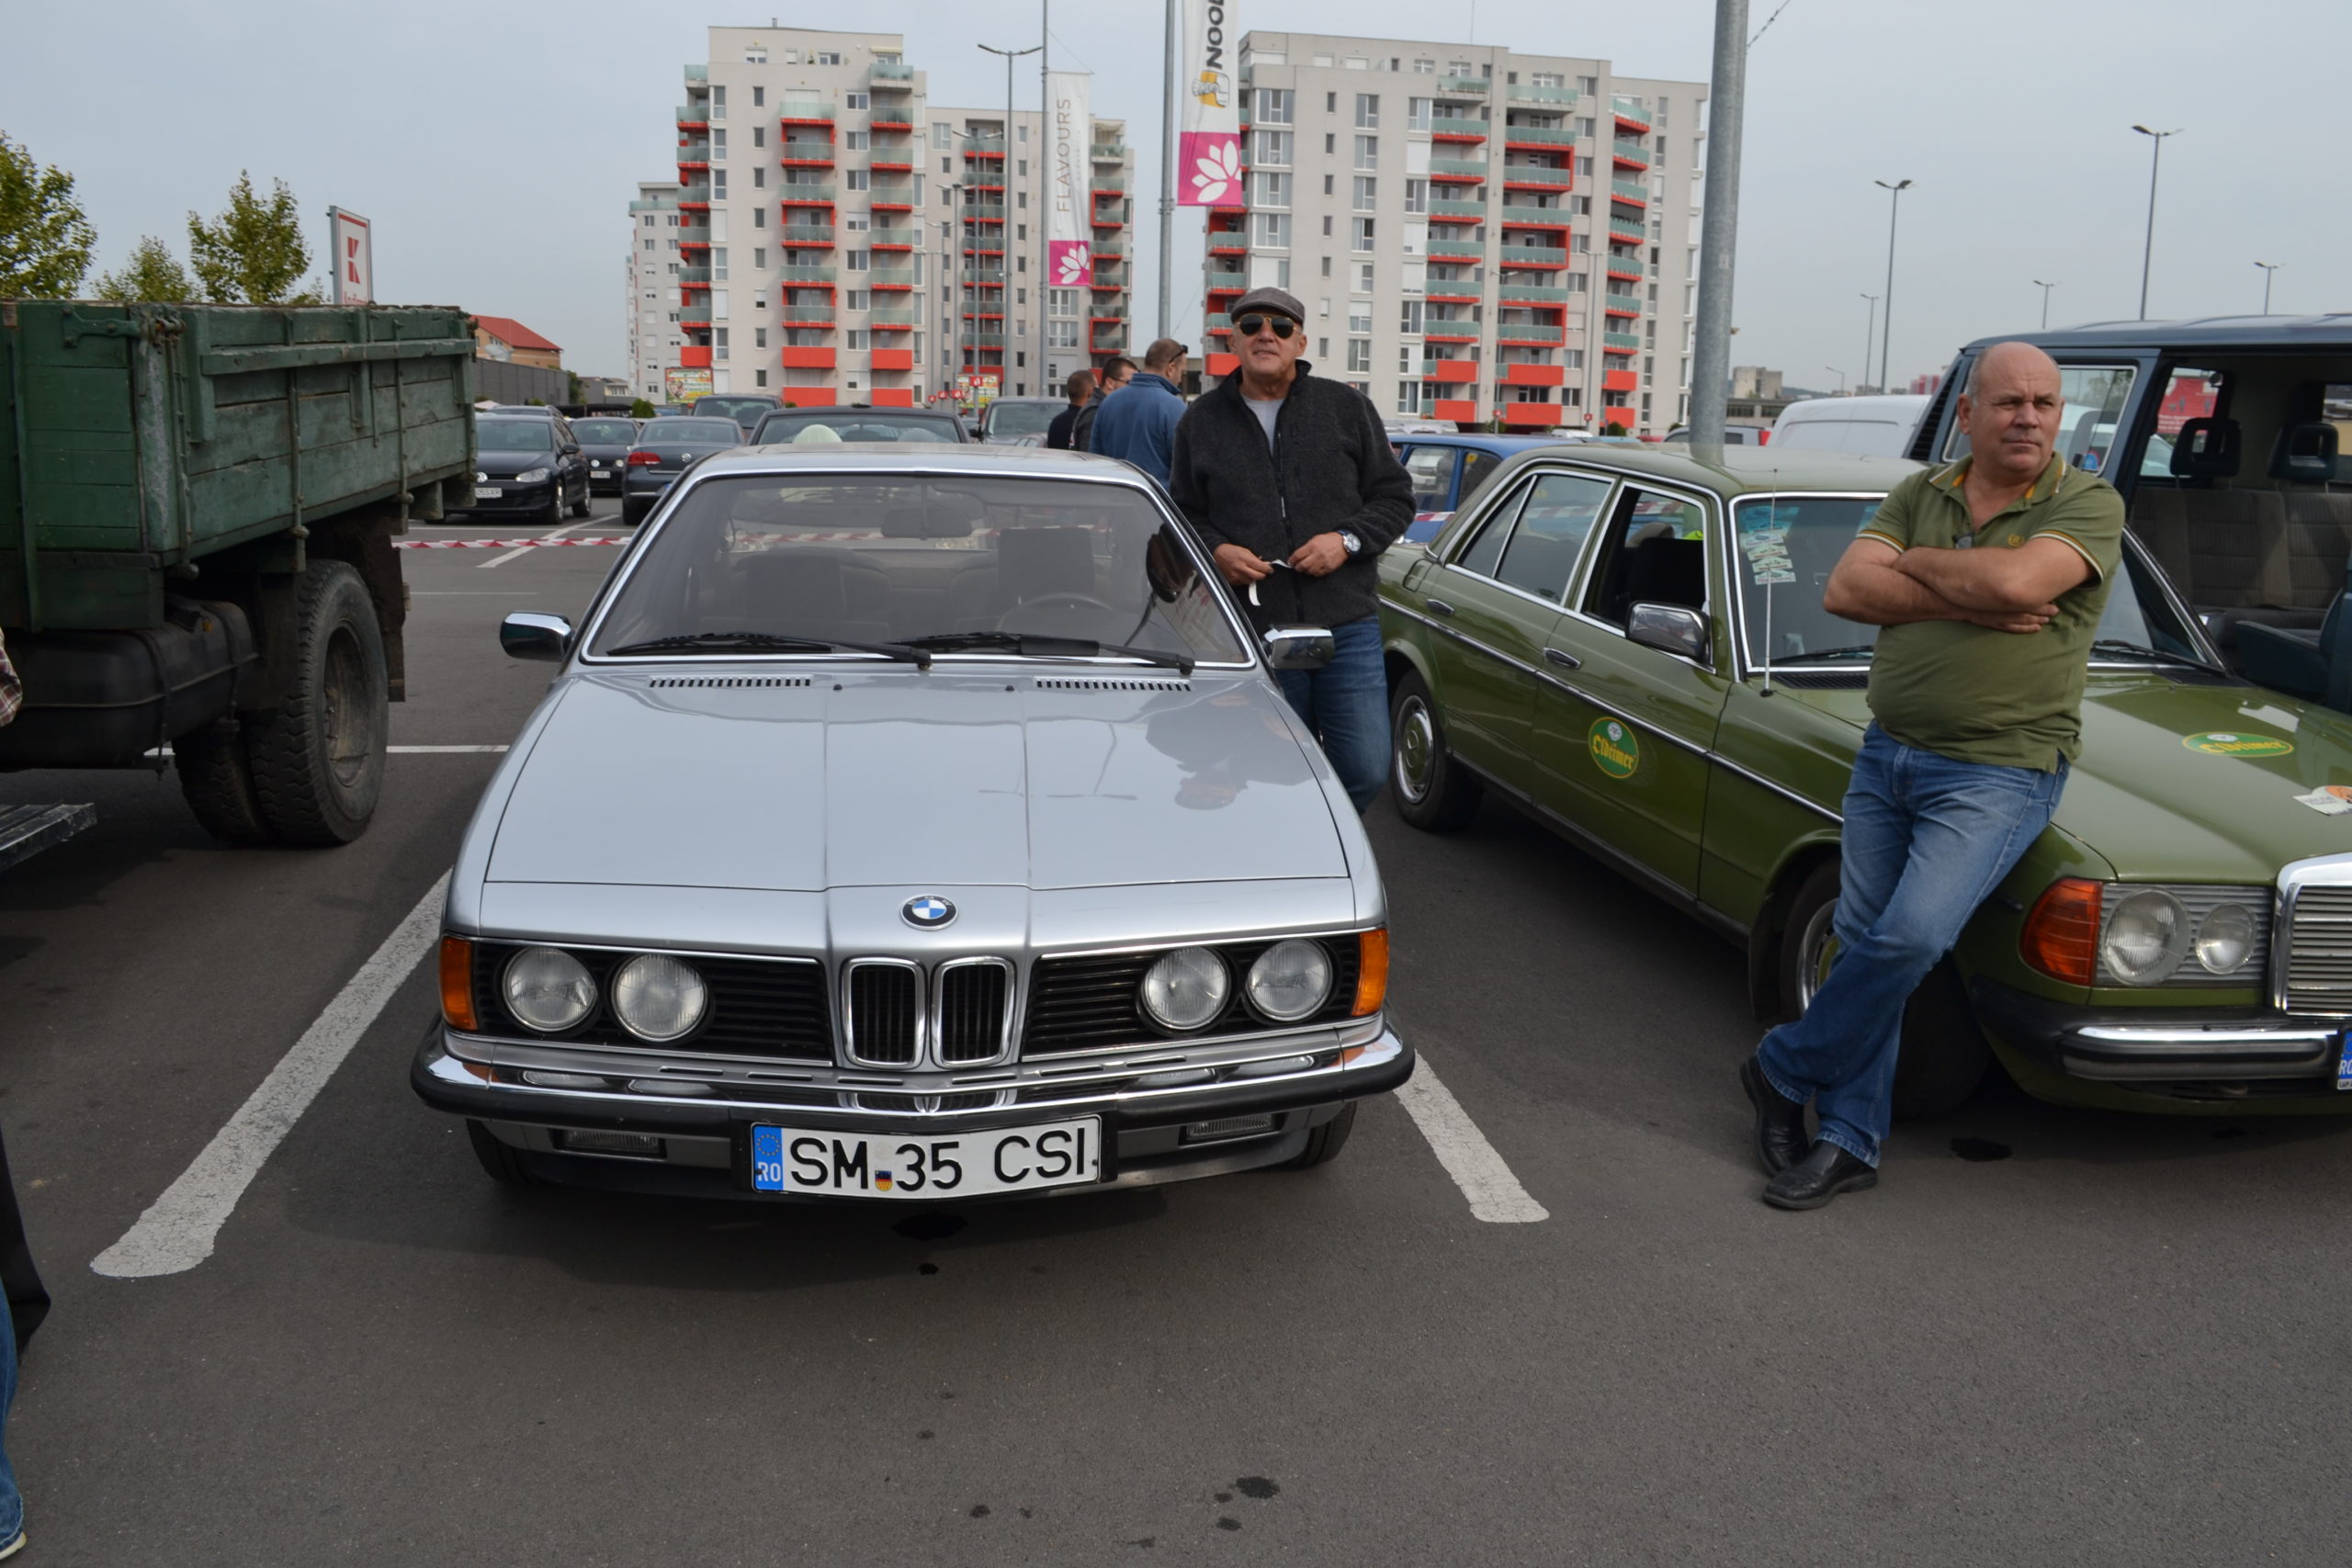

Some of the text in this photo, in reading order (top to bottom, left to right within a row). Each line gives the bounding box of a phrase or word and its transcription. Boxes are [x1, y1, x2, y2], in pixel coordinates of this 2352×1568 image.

[1057, 98, 1071, 212] FLAVOURS
[346, 236, 361, 285] K
[757, 1161, 781, 1182] RO
[790, 1127, 1086, 1191] SM 35 CSI
